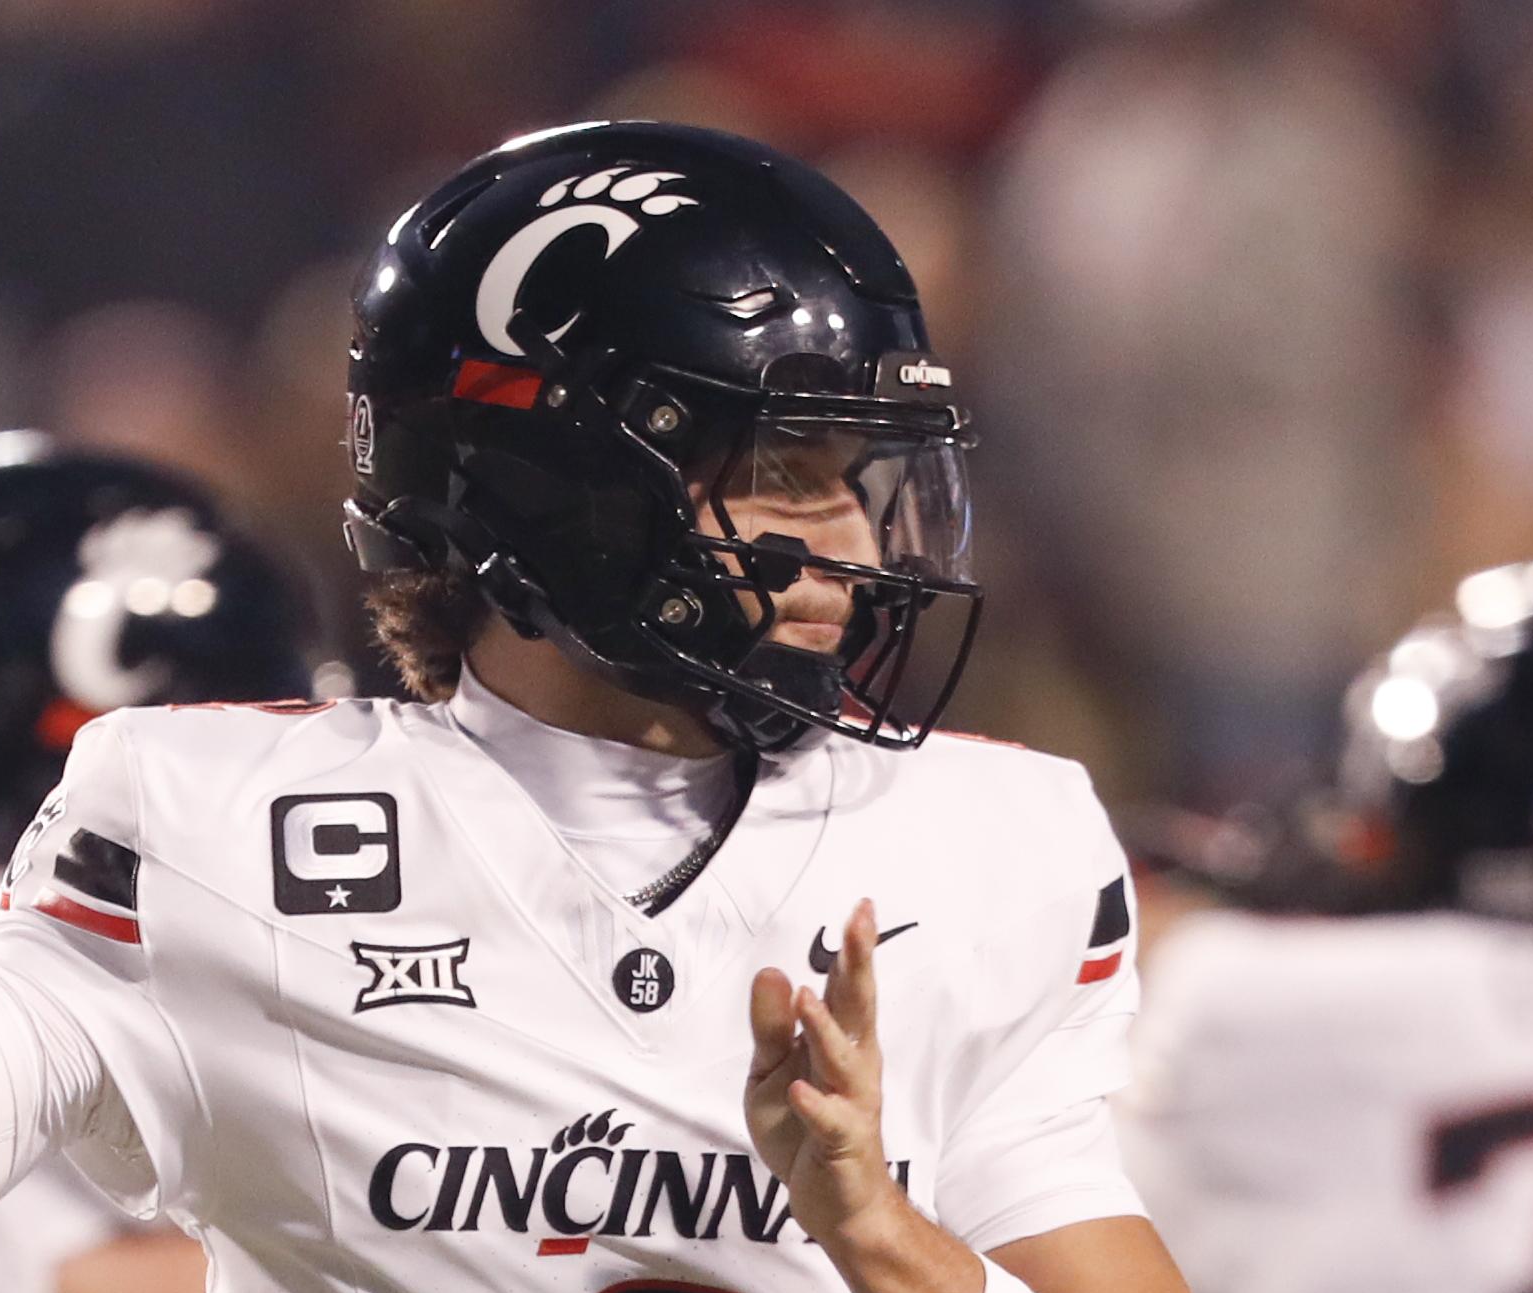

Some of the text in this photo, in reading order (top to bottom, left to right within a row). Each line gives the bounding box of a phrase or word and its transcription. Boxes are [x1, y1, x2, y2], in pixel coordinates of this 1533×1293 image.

[283, 800, 388, 880] C
[630, 979, 660, 1006] 58
[631, 953, 660, 979] JK
[369, 1142, 910, 1244] CINCINN
